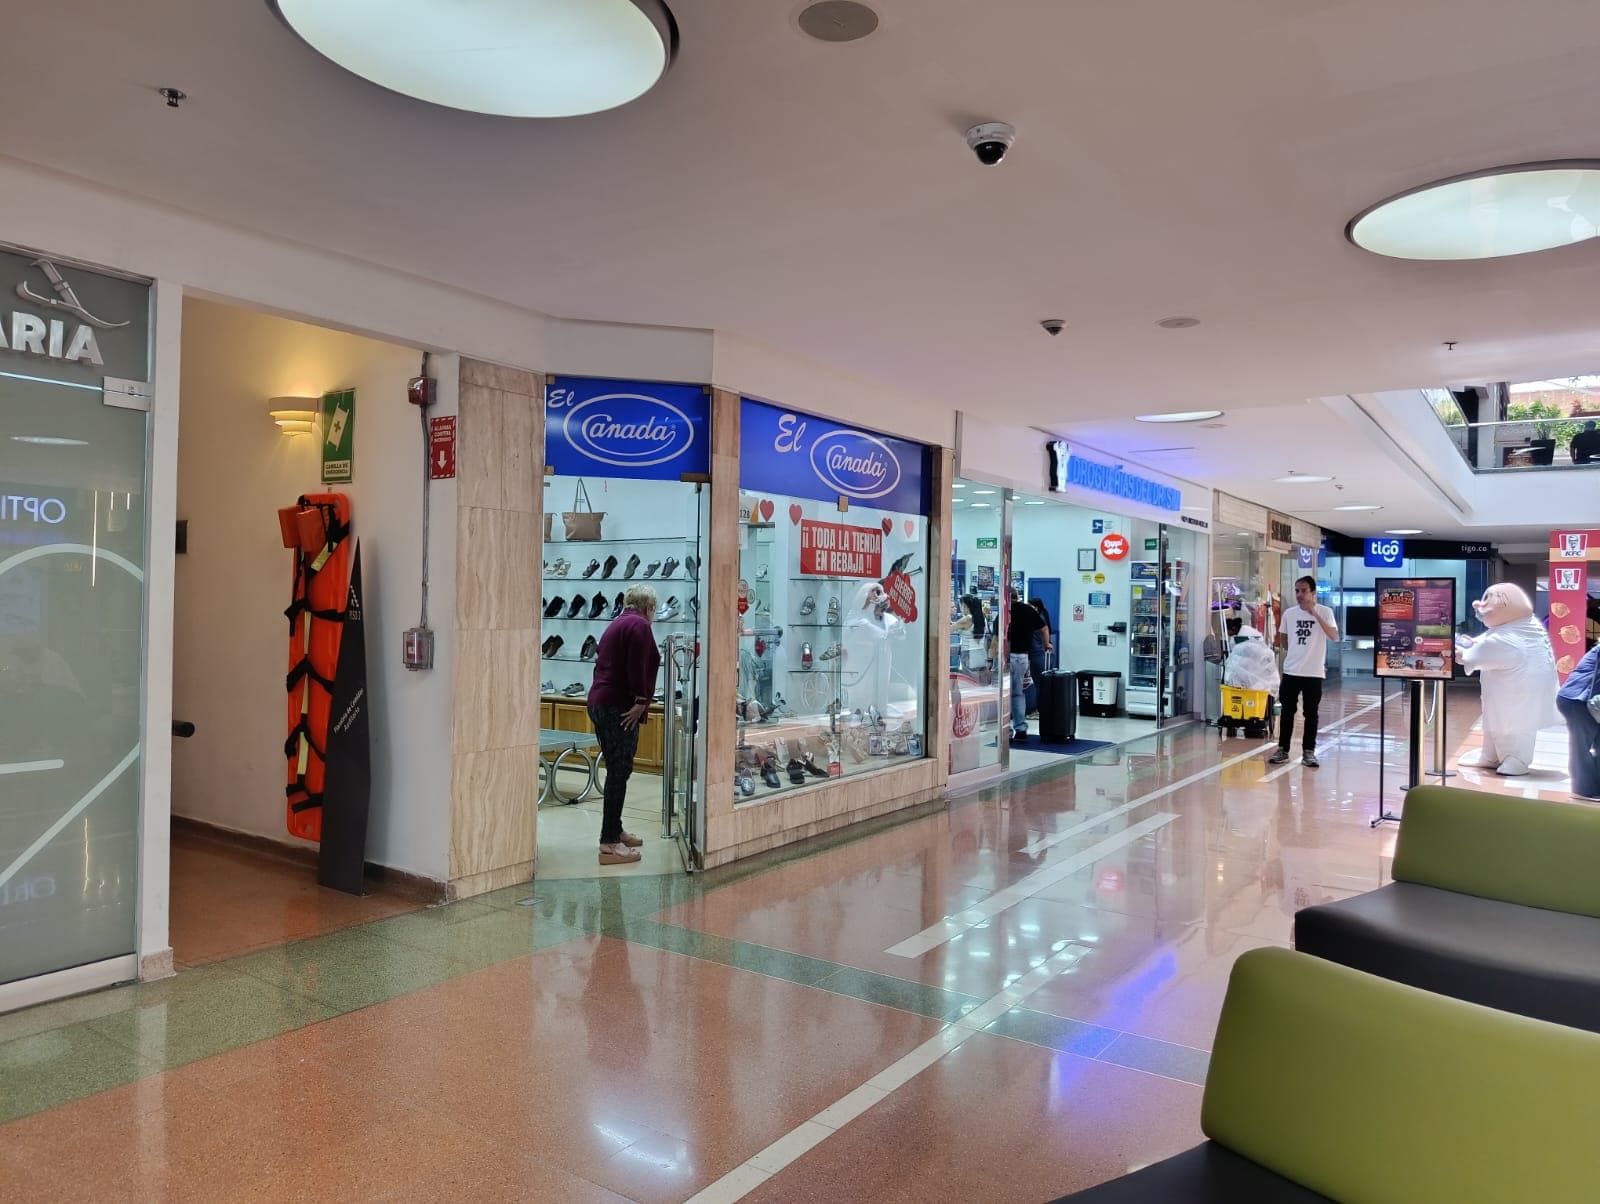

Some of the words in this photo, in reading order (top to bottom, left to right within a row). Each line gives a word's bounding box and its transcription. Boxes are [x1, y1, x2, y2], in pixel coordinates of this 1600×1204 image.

[547, 388, 575, 408] El
[582, 413, 676, 456] Canadá
[774, 413, 807, 453] El
[826, 445, 886, 491] Canadá
[811, 526, 836, 550] TODA
[838, 529, 850, 551] LA
[852, 531, 881, 553] TIENDA
[1461, 544, 1488, 554] tigo.co
[815, 549, 828, 572] EN
[830, 551, 864, 573] REBAJA
[1295, 629, 1311, 637] DO
[1296, 620, 1315, 628] JUST
